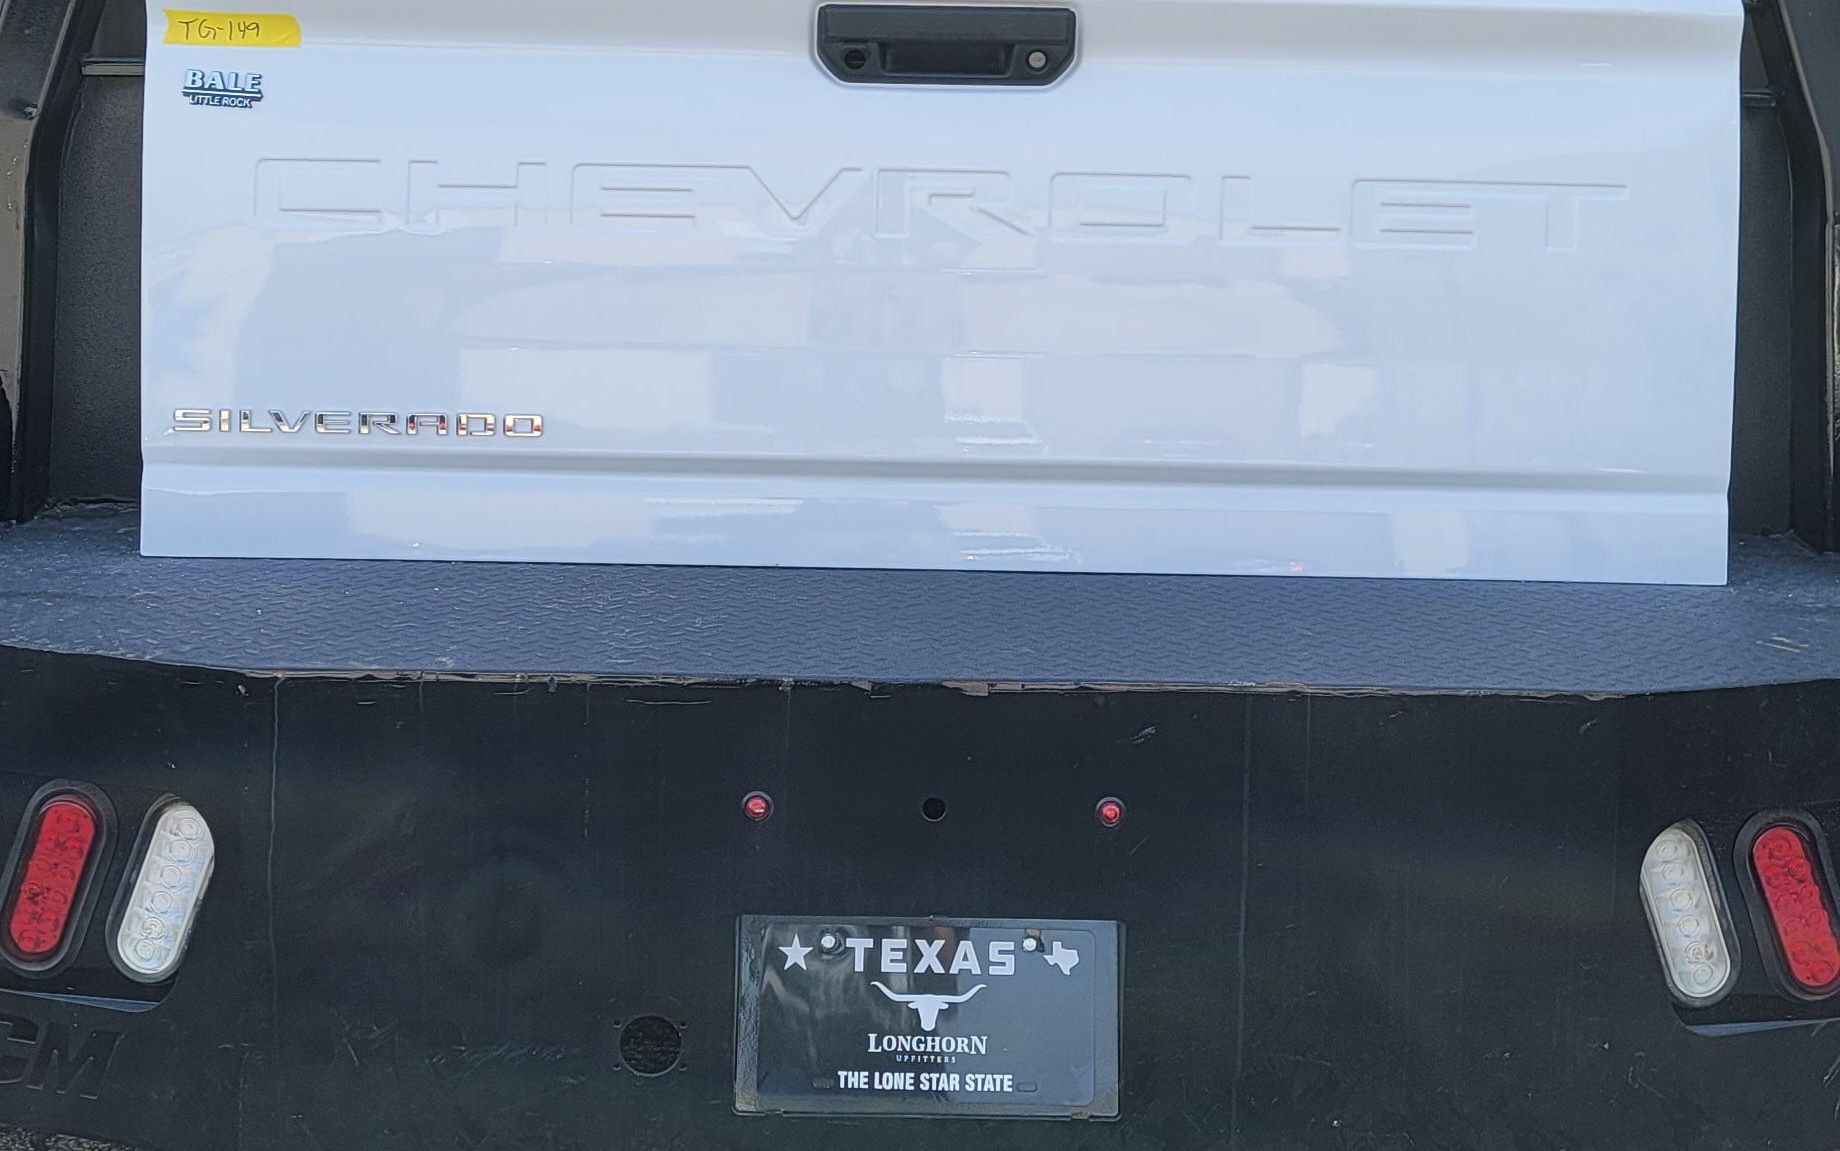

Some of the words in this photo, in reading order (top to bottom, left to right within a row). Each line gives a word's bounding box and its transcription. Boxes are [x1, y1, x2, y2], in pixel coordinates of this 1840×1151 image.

[184, 68, 263, 92] BALE
[189, 94, 221, 106] LITTLE
[222, 96, 253, 108] ROCK
[255, 157, 1629, 251] CHEVROLET
[172, 408, 543, 438] SILVERADO
[845, 937, 1016, 976] TEXAS
[867, 1033, 988, 1055] LONGHORN
[895, 1055, 957, 1064] UPFITTERS
[838, 1070, 869, 1090] THE
[873, 1070, 915, 1091] LONE
[919, 1071, 960, 1092] STAR
[964, 1072, 1014, 1093] STATE
